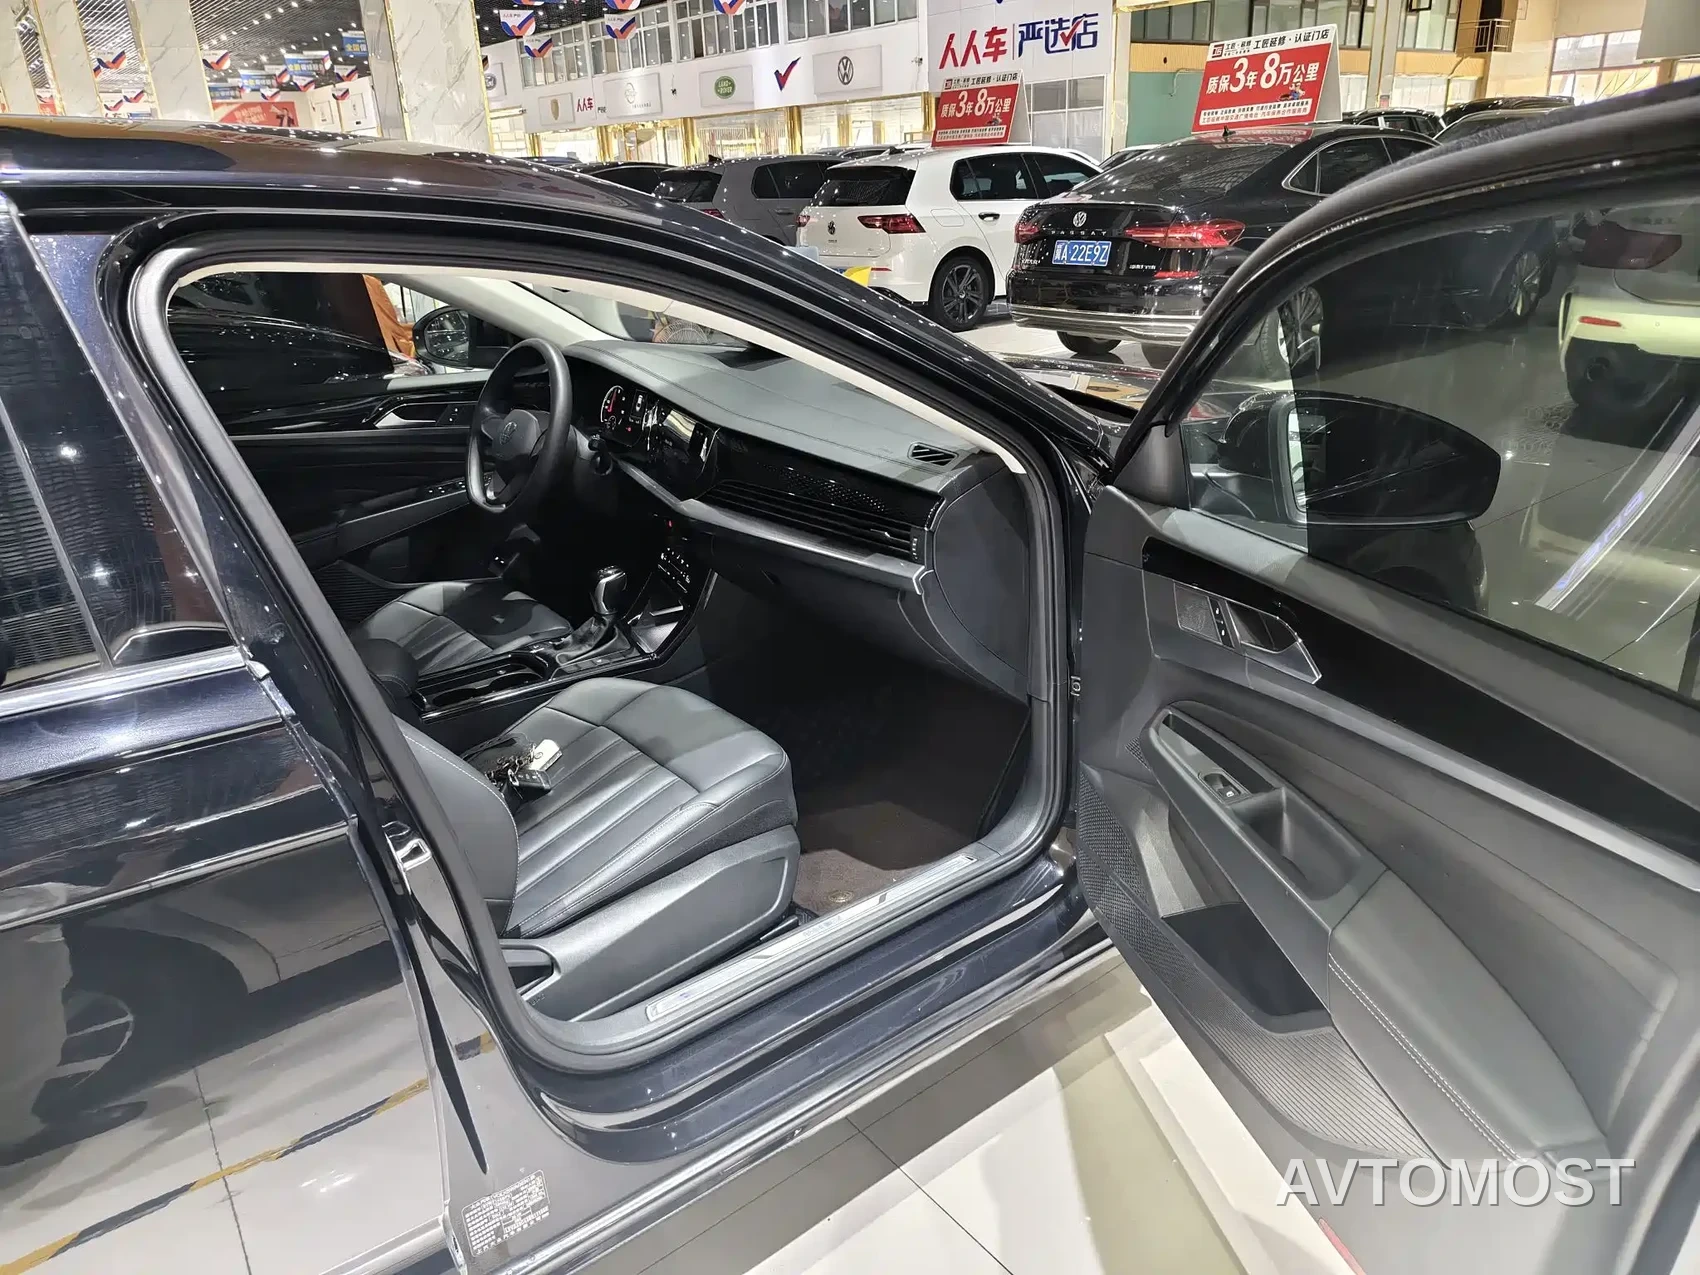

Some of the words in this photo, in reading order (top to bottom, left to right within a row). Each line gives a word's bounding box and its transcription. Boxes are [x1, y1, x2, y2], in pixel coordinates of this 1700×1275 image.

[938, 26, 1008, 70] 人人车
[1018, 13, 1099, 58] 严选店
[1206, 53, 1320, 95] 质保3年8万公里
[940, 88, 1012, 118] 质保3年8万公里
